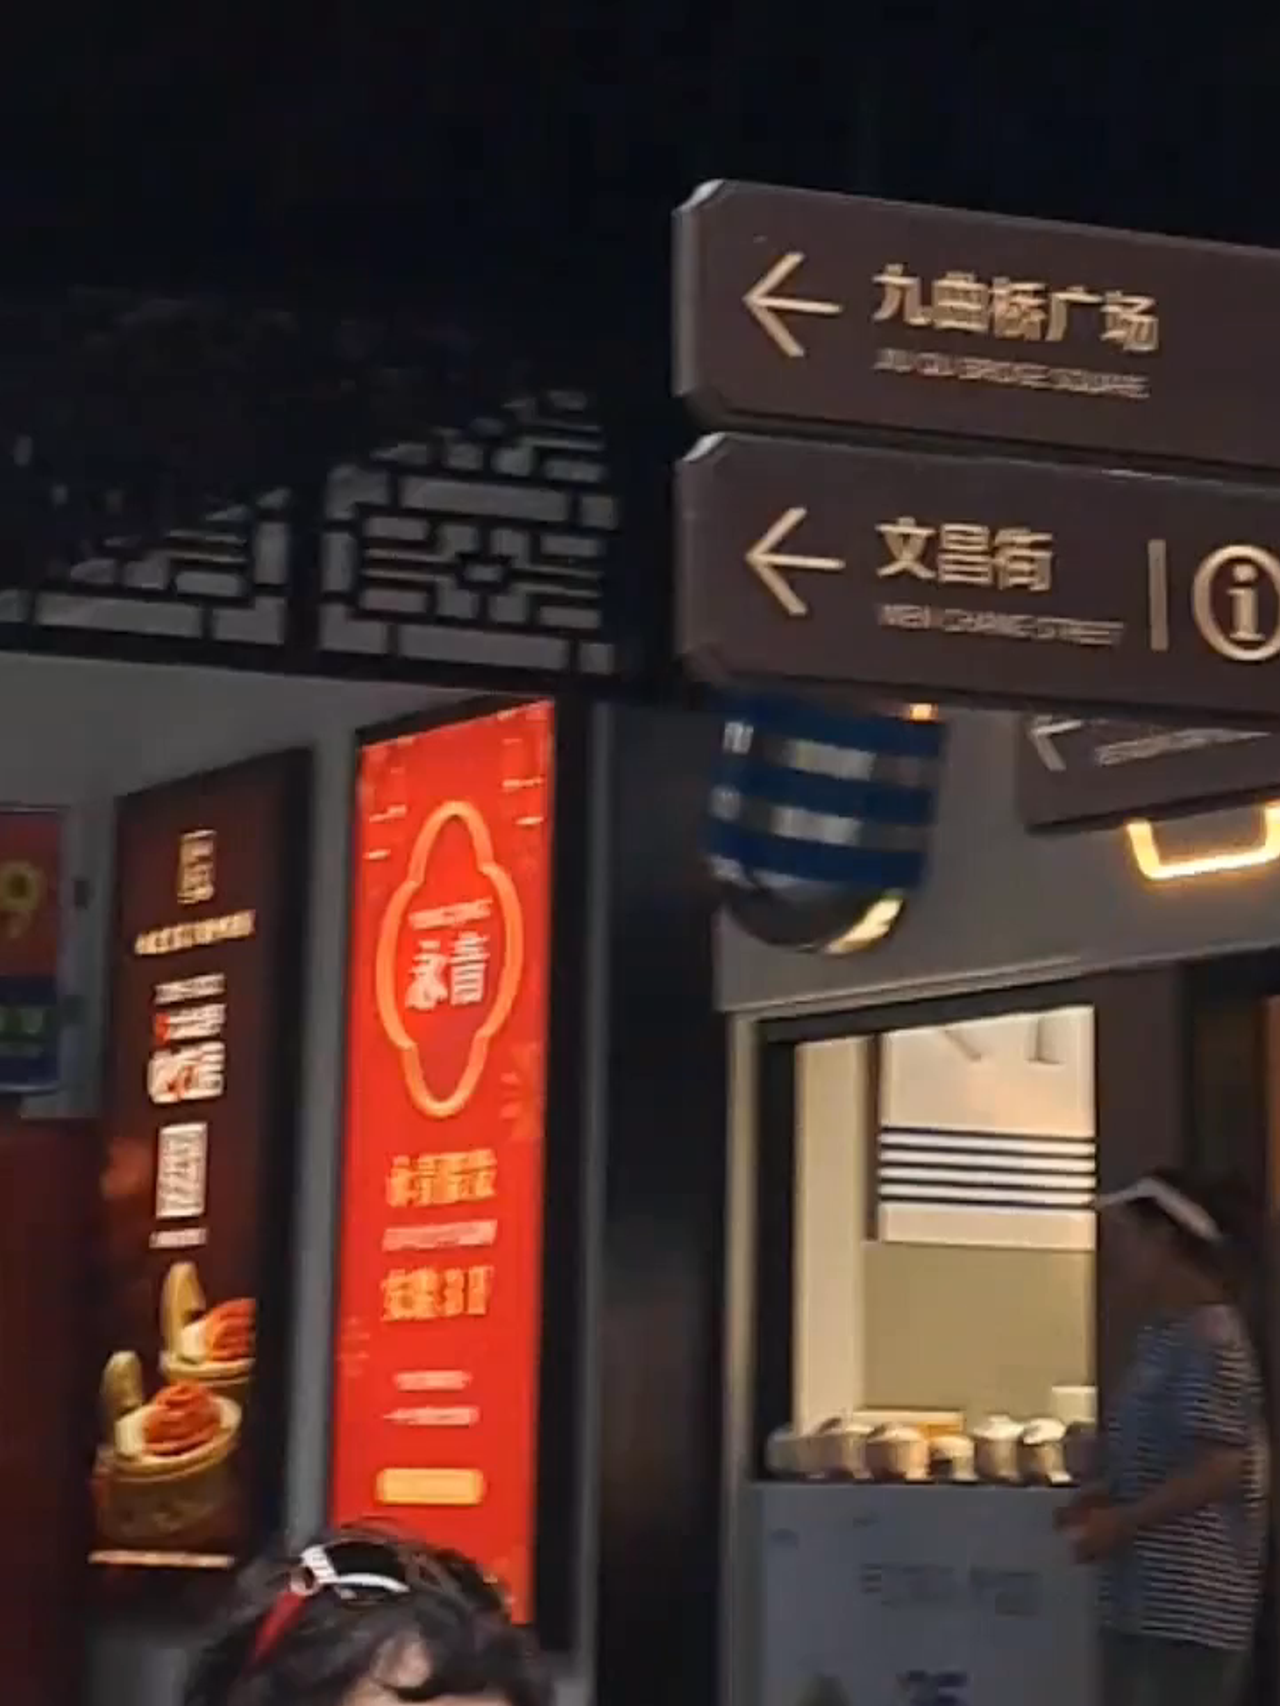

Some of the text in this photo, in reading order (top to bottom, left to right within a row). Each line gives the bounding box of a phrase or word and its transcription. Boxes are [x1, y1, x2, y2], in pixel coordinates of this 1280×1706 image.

[871, 262, 1160, 353] 九曲桥广场
[874, 516, 1054, 593] 文昌街
